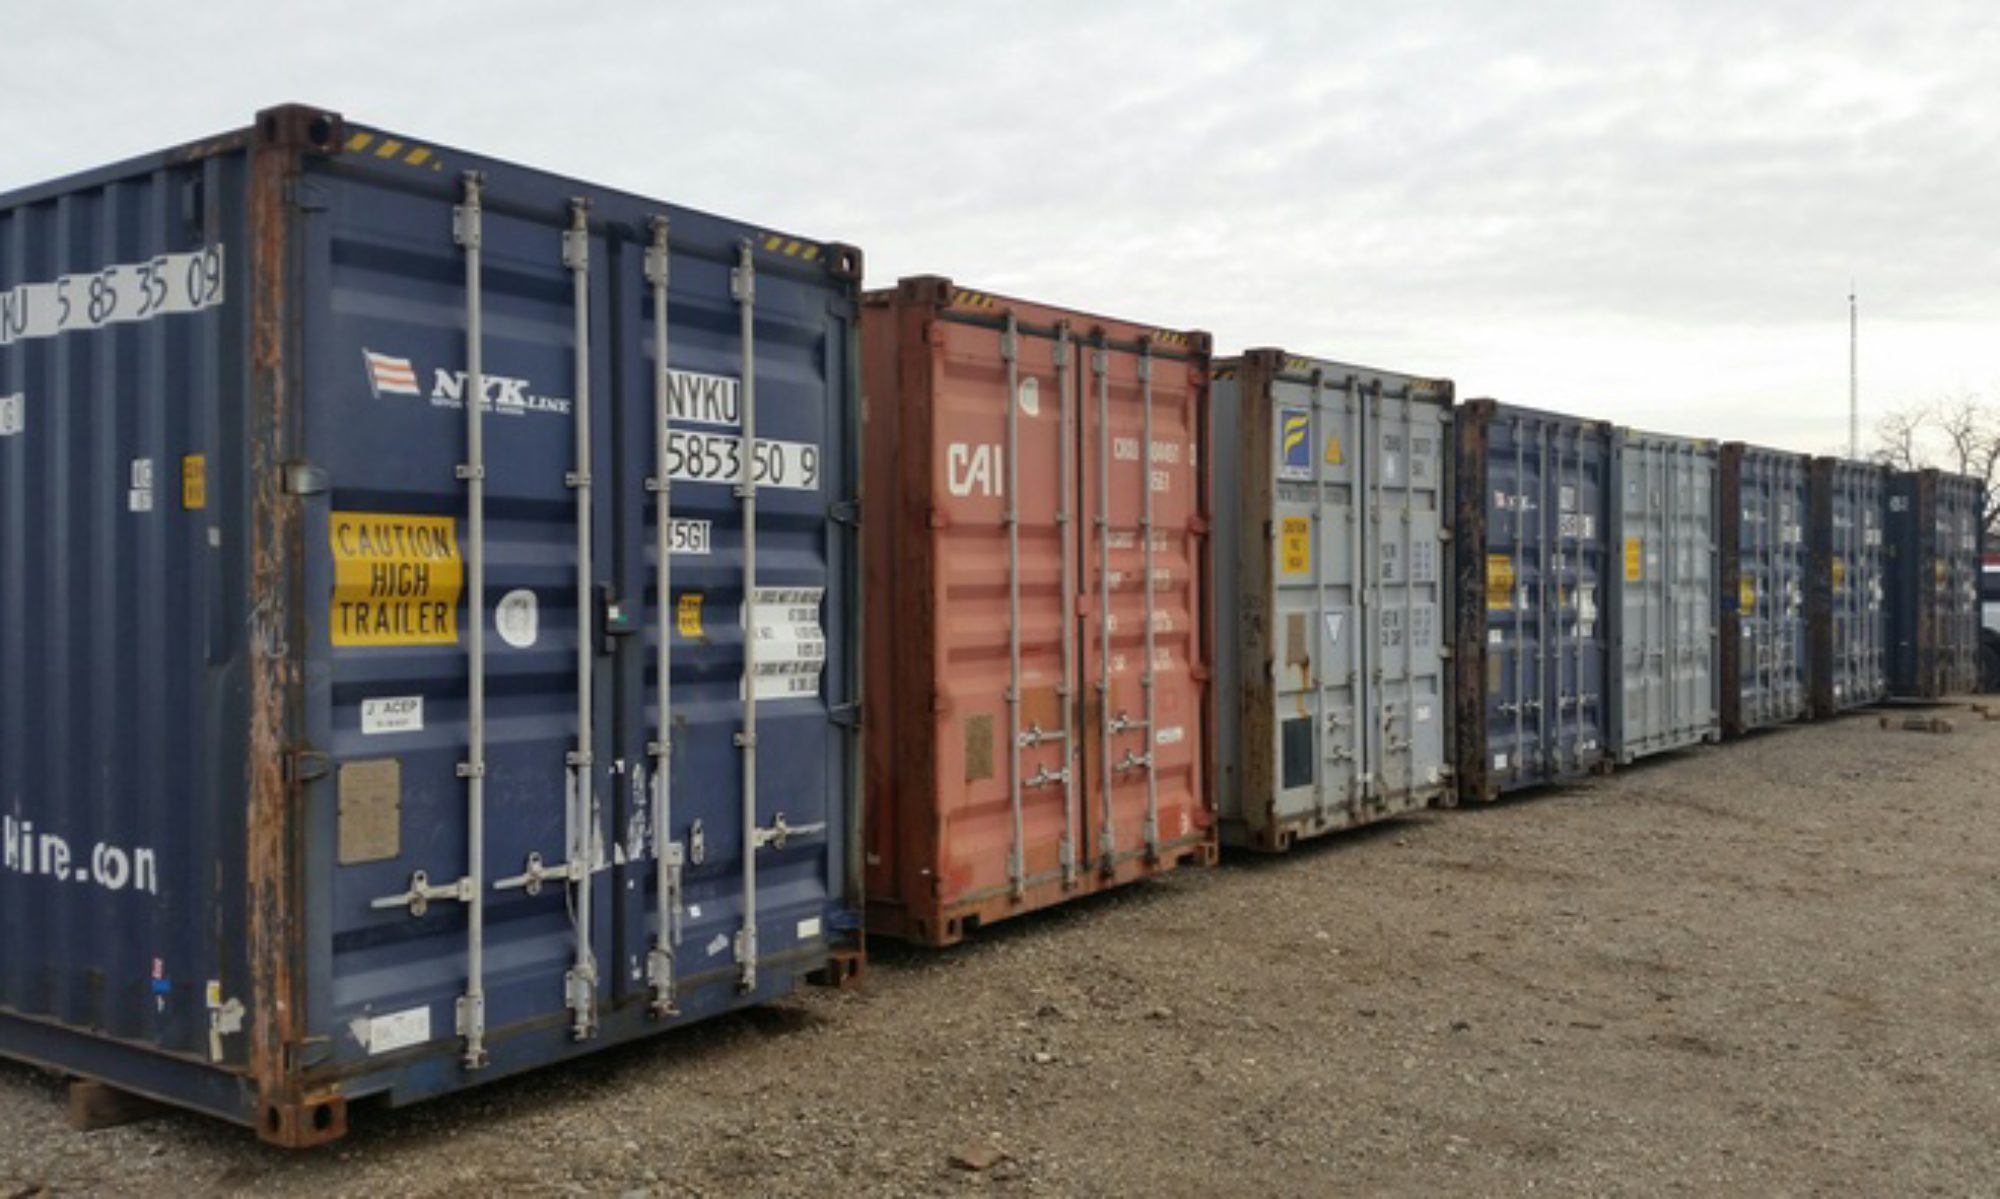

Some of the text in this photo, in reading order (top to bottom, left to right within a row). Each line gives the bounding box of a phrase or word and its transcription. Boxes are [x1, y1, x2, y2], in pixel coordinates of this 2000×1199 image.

[431, 367, 529, 407] NYK
[527, 395, 570, 415] LINE
[667, 372, 740, 422] NYKU
[947, 442, 1003, 497] CAI
[337, 522, 452, 558] CAUTION
[370, 562, 430, 597] HIGH
[339, 601, 449, 636] TRAILER
